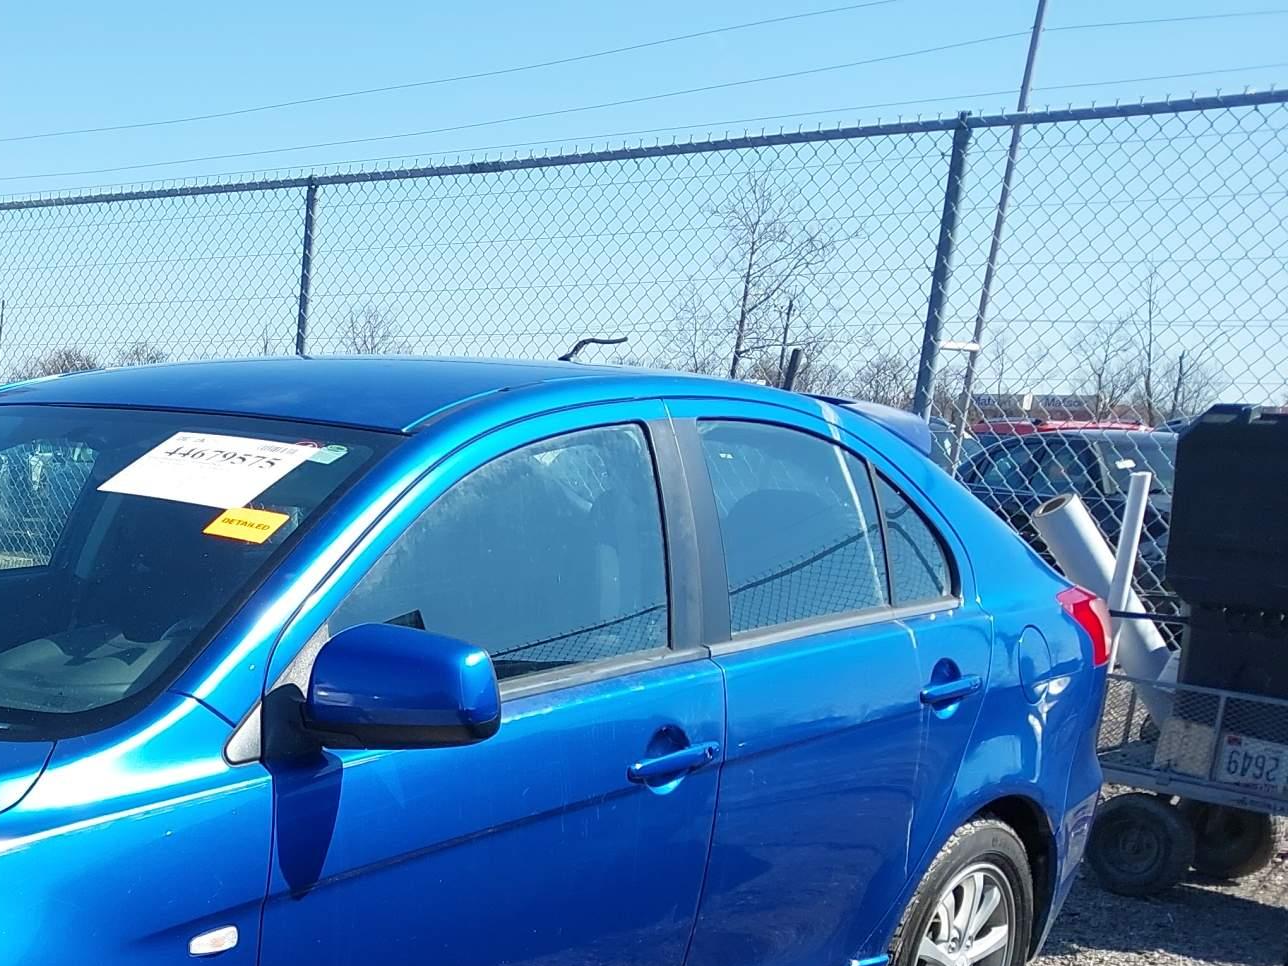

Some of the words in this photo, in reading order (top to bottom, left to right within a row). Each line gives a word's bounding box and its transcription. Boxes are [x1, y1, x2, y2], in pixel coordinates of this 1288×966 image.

[164, 445, 281, 469] 44679575
[221, 516, 271, 532] DETAILED
[1226, 749, 1280, 782] 2649
